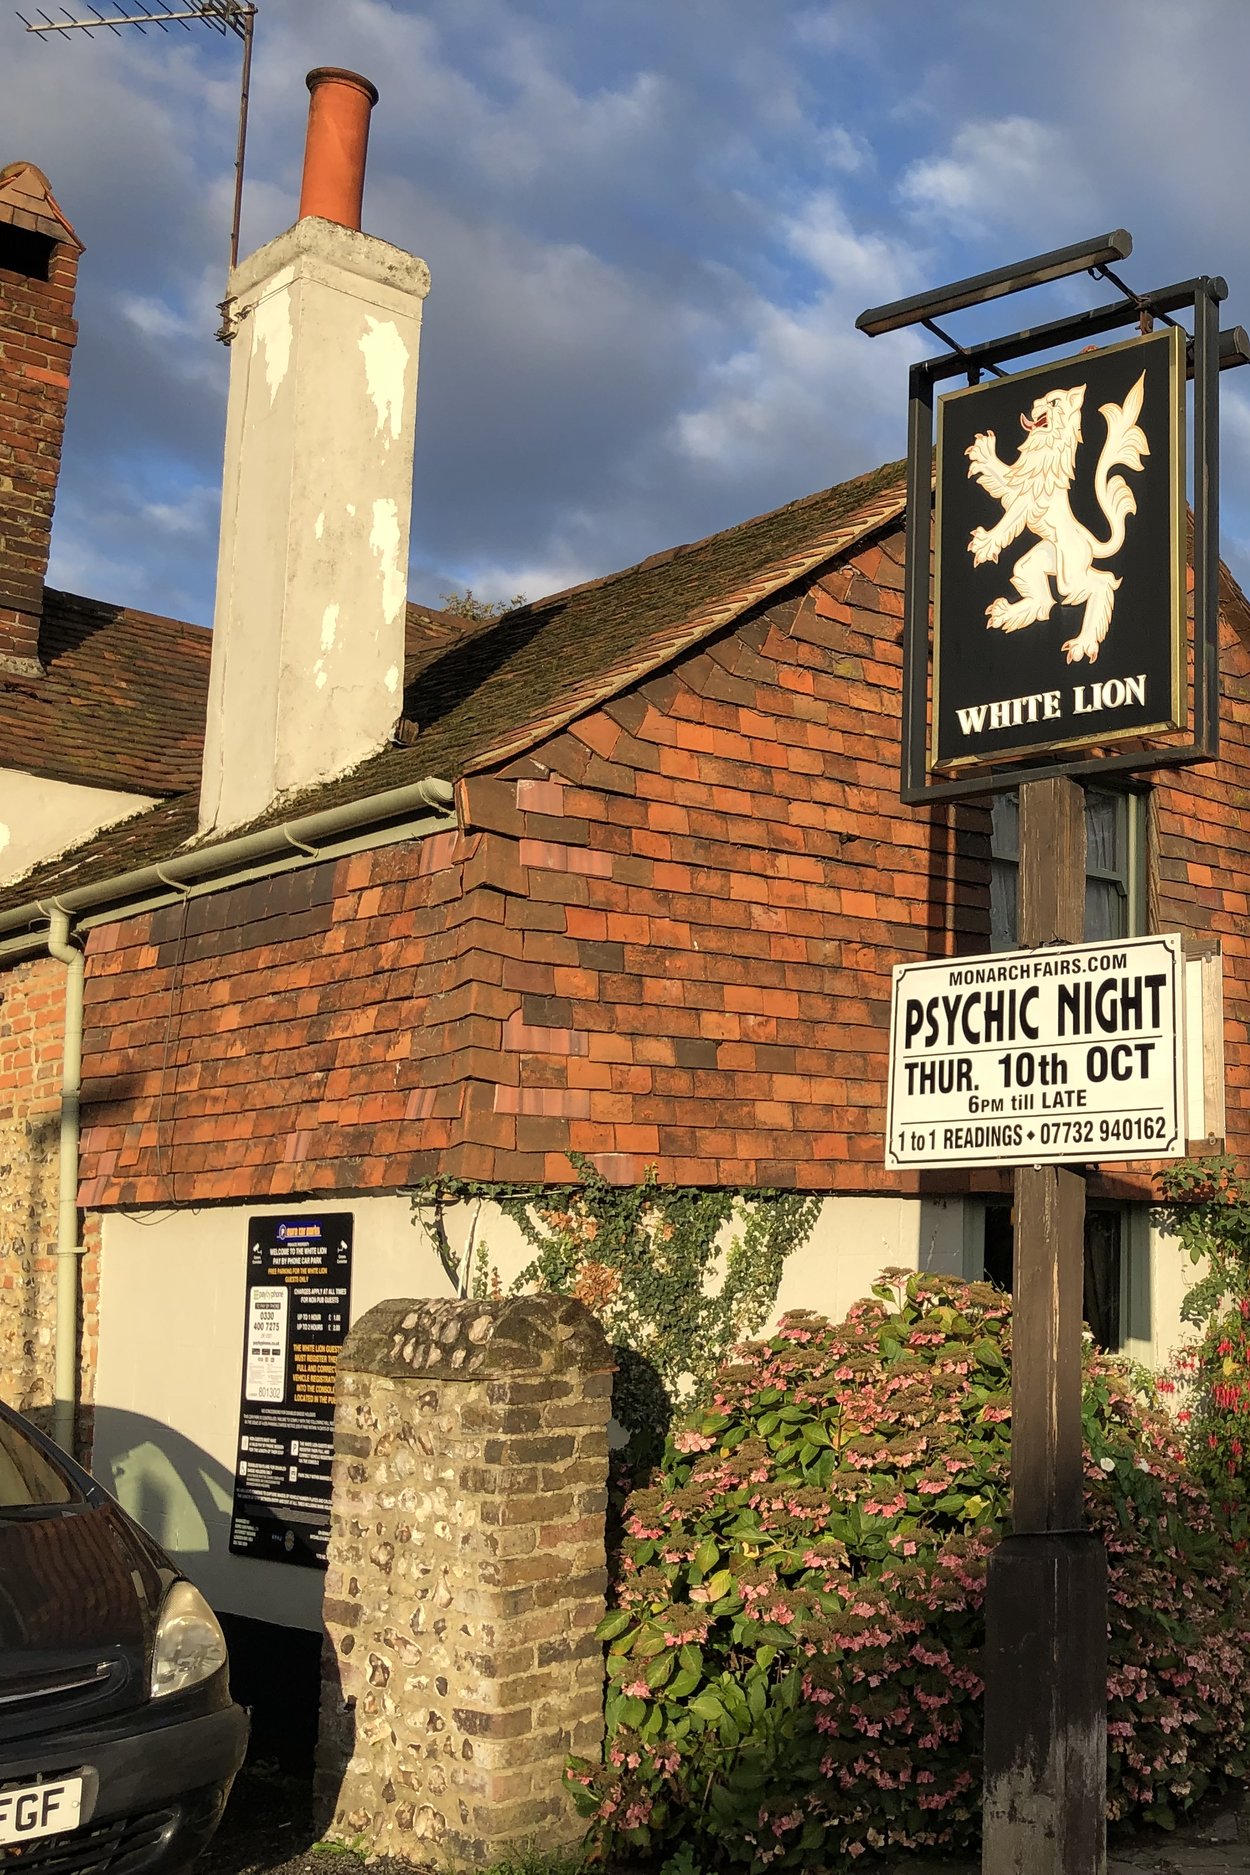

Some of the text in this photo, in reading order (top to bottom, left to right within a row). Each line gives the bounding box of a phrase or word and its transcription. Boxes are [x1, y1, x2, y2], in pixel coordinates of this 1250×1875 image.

[955, 674, 1147, 735] WHITE LION
[949, 953, 1128, 987] MONARCHFAIRS.COM
[905, 973, 1167, 1049] PSYCHIC NIGHT
[904, 1042, 1156, 1096] THUR. 10th OCT
[1011, 1093, 1034, 1111] till
[1041, 1089, 1087, 1109] LATE
[898, 1116, 1167, 1152] 1 to 1 READINGS 07732 940162
[254, 1322, 279, 1331] 400 7275
[260, 1312, 274, 1320] 0330
[259, 1387, 280, 1398] 801302
